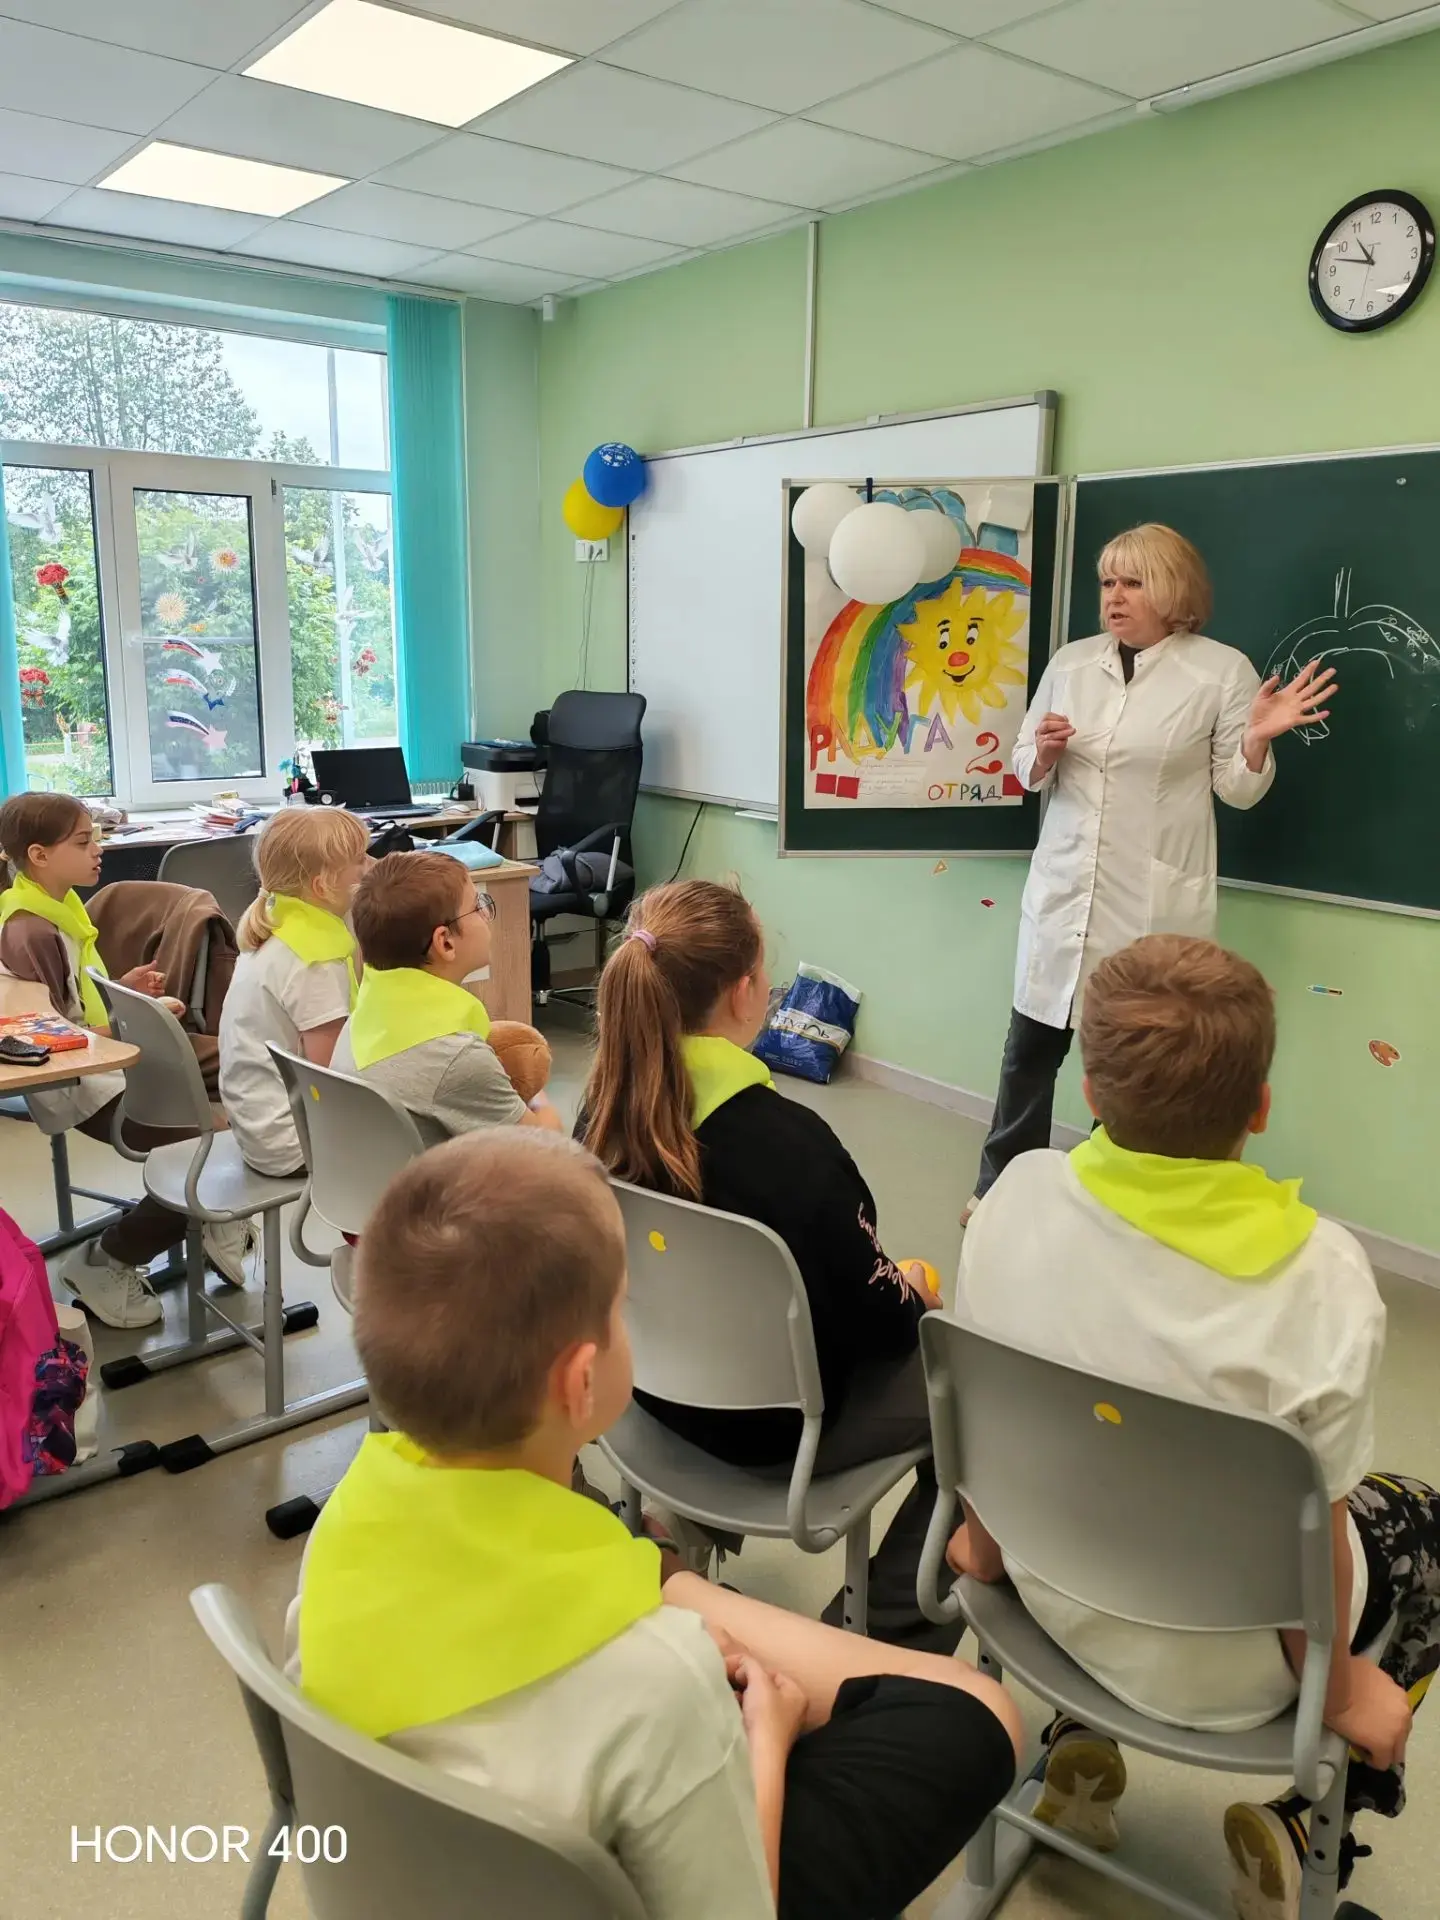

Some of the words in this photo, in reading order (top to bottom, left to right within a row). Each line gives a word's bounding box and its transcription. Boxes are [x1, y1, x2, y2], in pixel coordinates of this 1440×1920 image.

[1370, 212, 1382, 224] 12
[1352, 222, 1361, 233] 11
[1406, 226, 1414, 238] 2
[1337, 241, 1348, 253] 10
[1410, 247, 1418, 259] 3
[1329, 265, 1336, 277] 9
[1404, 271, 1411, 282] 4
[1333, 286, 1341, 297] 8
[1348, 298, 1355, 311] 7
[1366, 301, 1374, 312] 6
[810, 711, 954, 771] РАДУГА
[965, 731, 1004, 774] 2
[928, 783, 1002, 802] ОТРЯД
